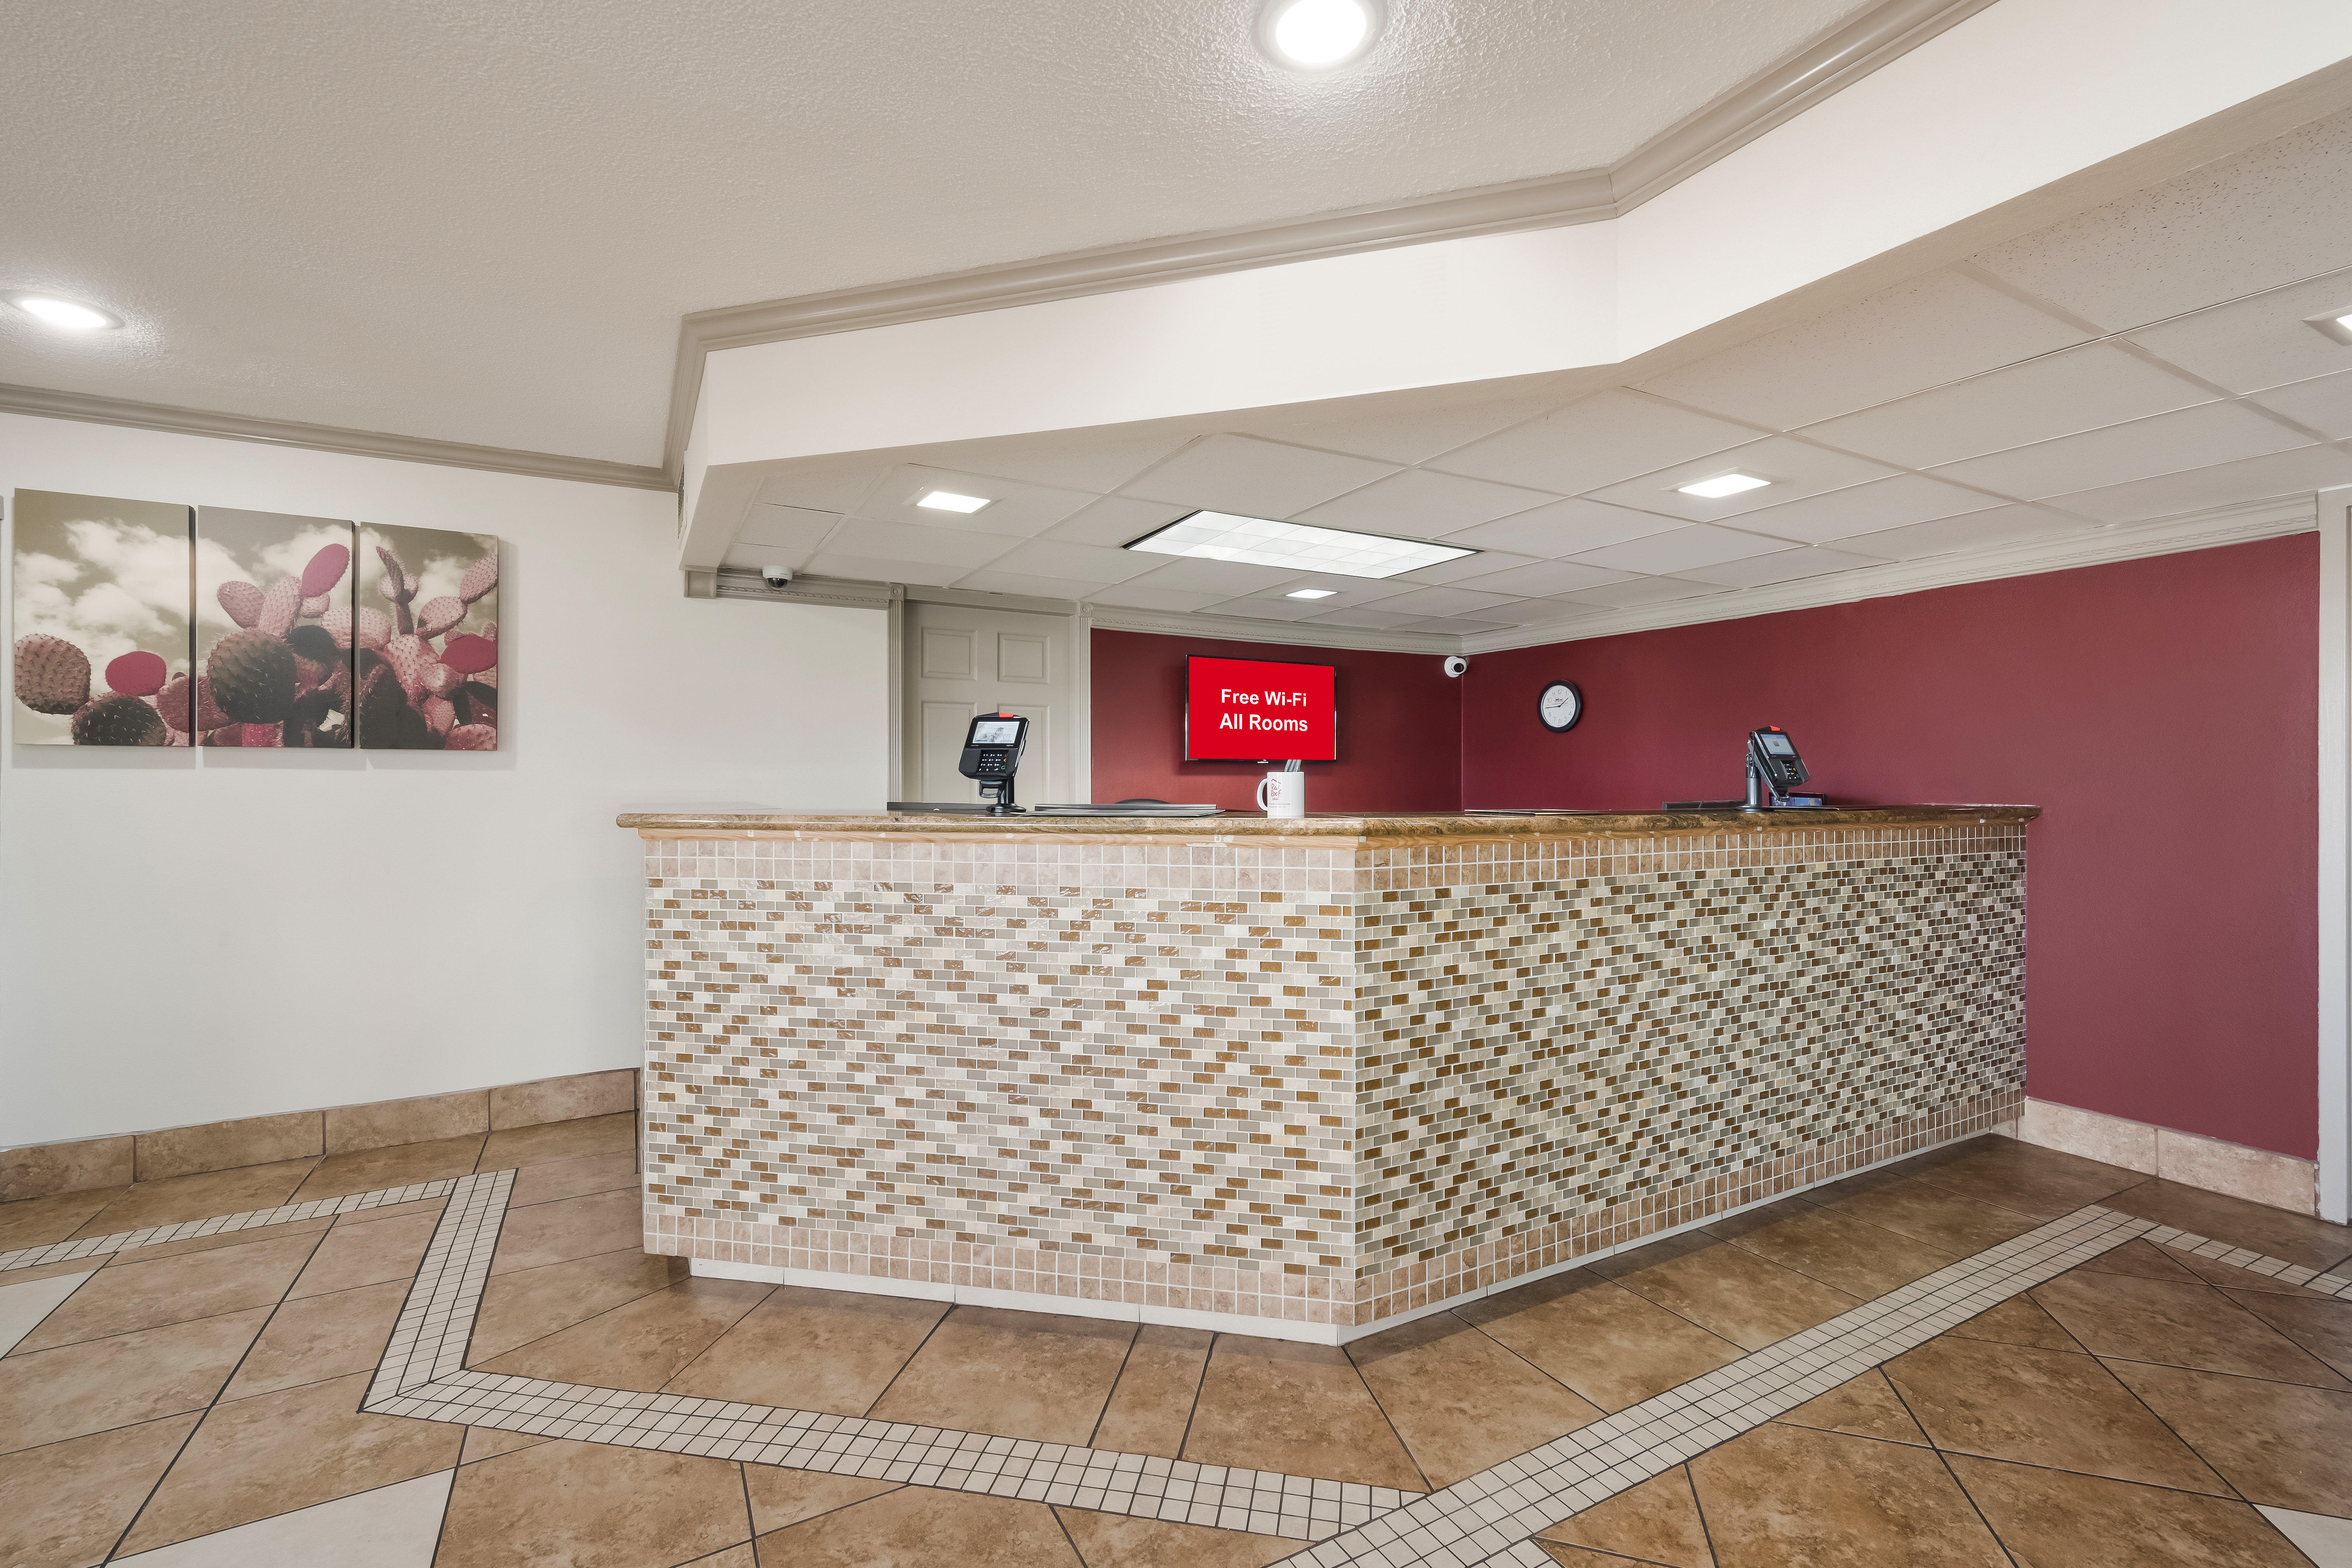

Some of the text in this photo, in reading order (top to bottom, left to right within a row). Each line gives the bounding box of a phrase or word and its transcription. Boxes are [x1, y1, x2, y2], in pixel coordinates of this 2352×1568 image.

[1222, 689, 1306, 706] Free Wi-Fi
[1220, 713, 1307, 731] All Rooms
[1271, 789, 1281, 798] Roof
